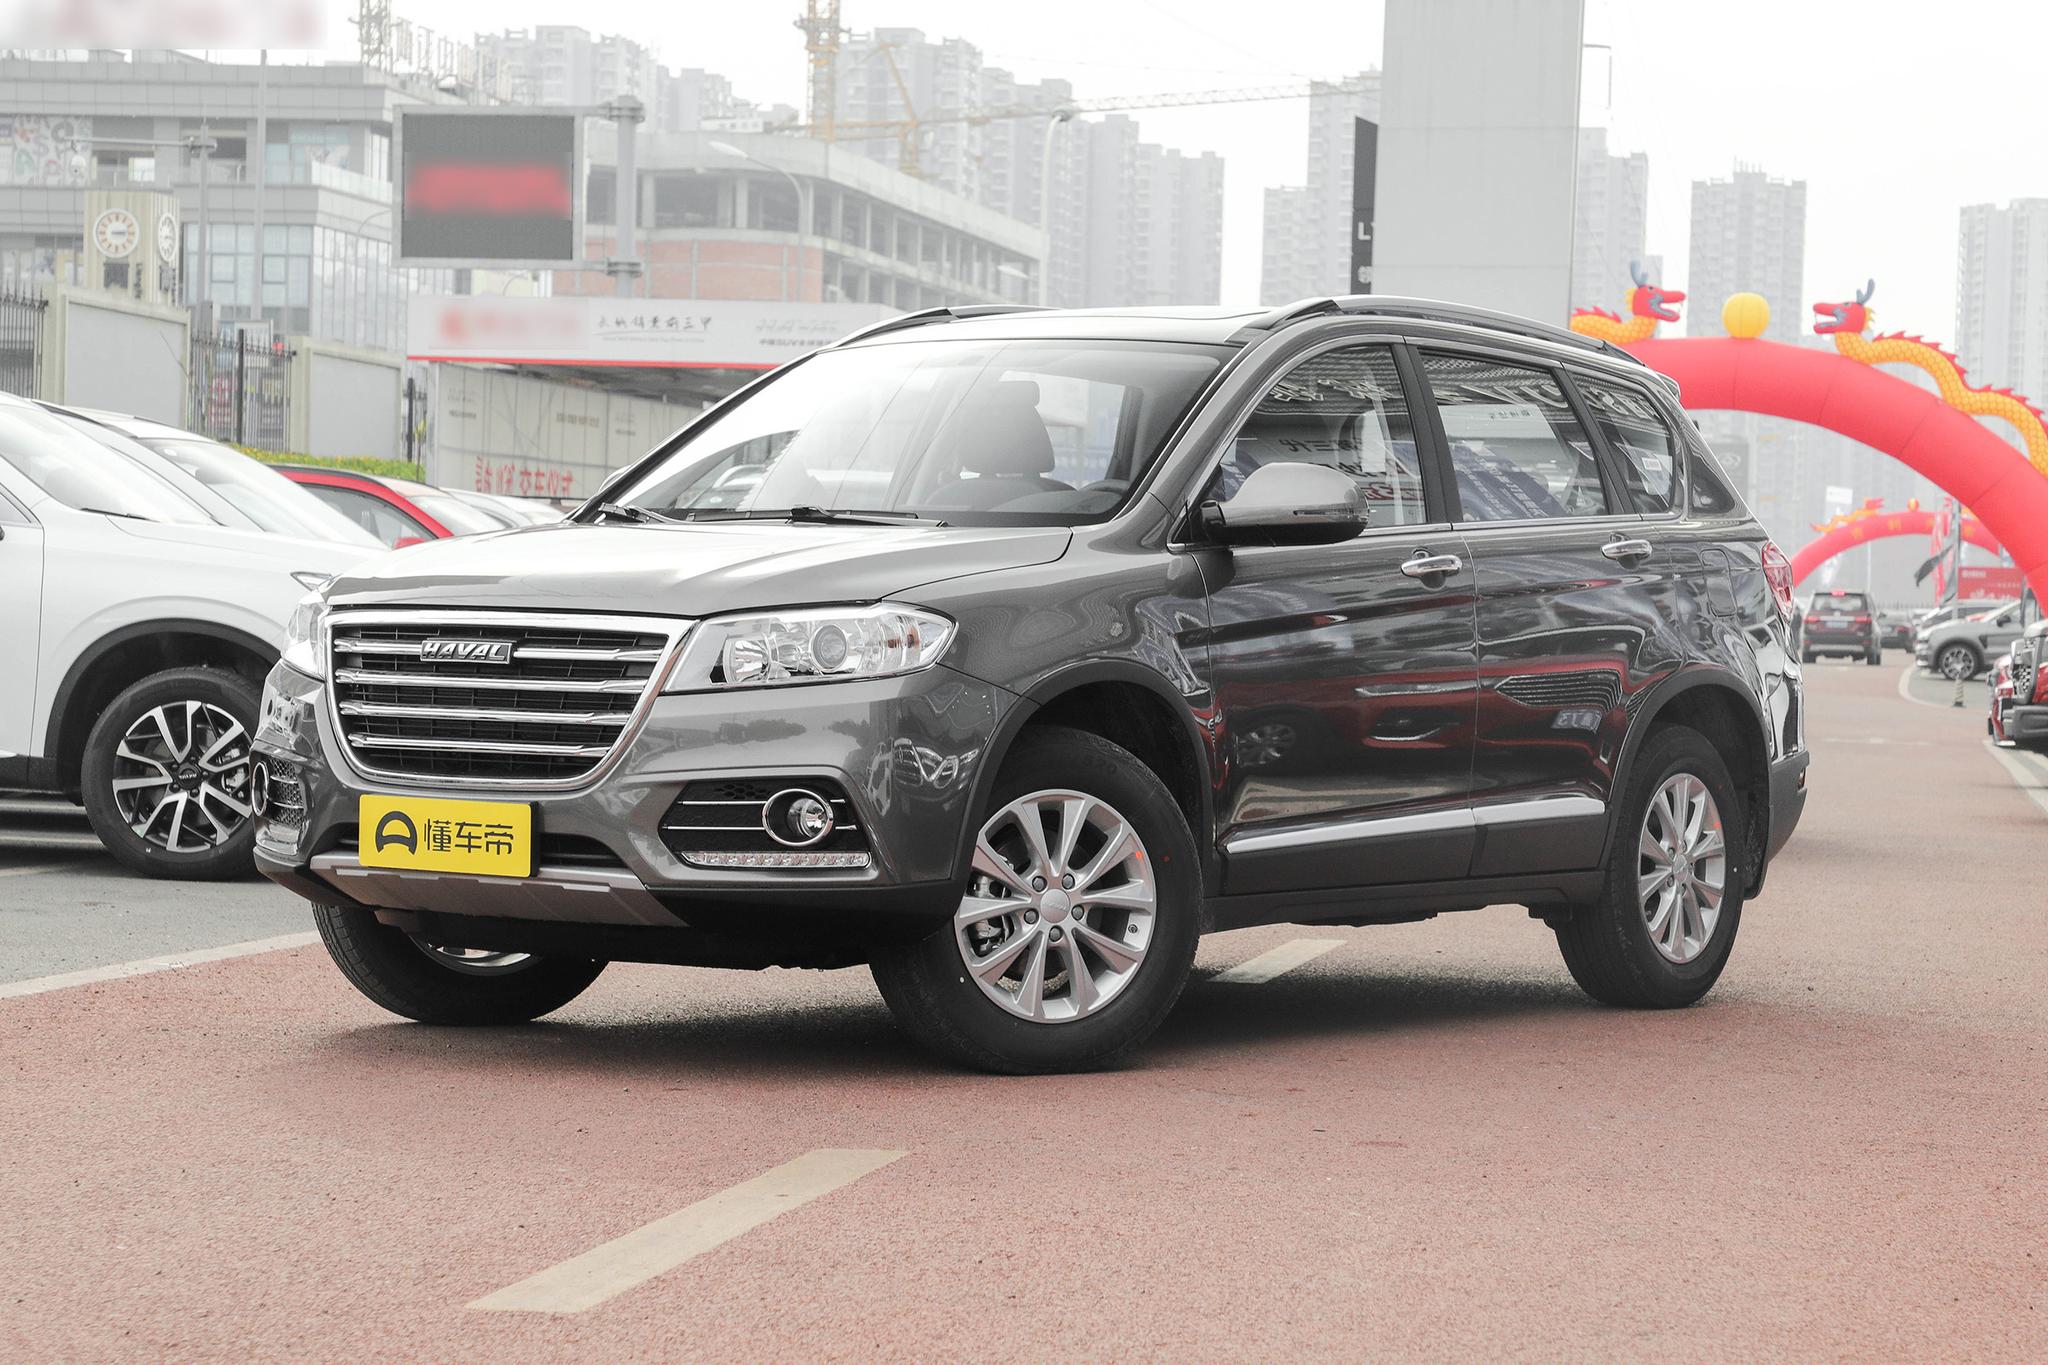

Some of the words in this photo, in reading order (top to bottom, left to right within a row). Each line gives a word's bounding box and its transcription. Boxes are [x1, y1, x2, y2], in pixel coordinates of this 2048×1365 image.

[422, 642, 505, 661] HAVAL
[423, 818, 514, 855] 懂车帝
